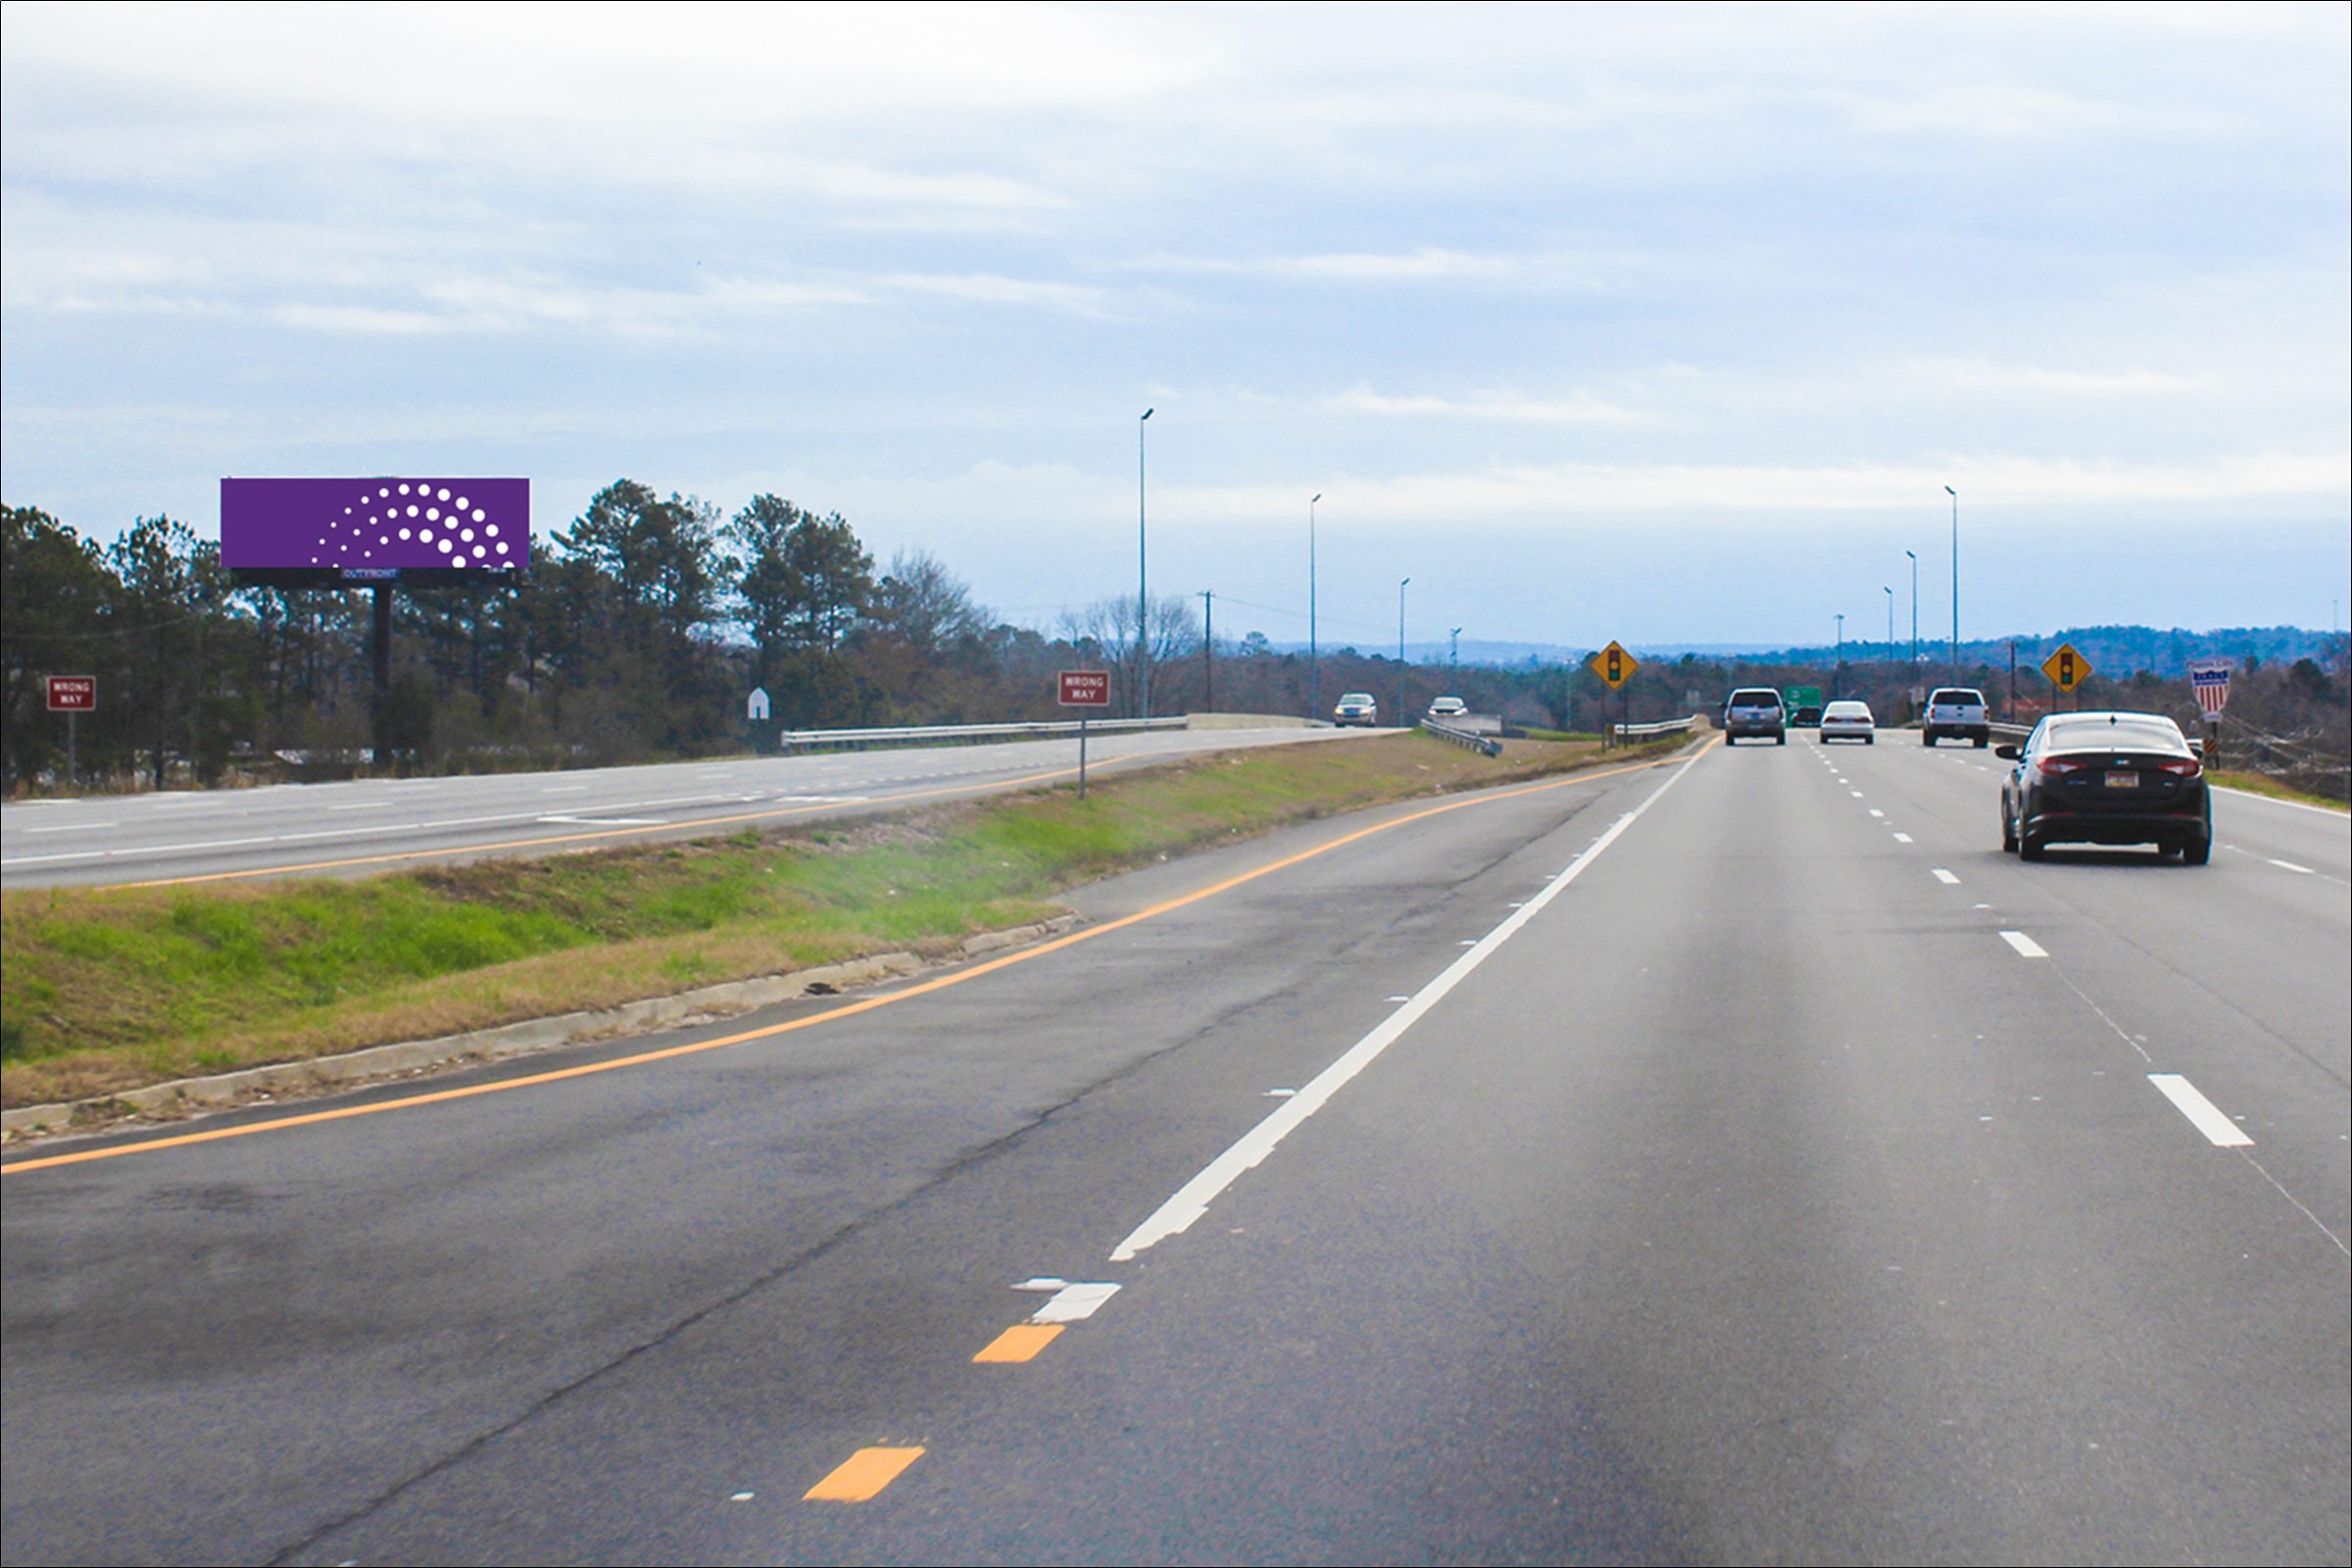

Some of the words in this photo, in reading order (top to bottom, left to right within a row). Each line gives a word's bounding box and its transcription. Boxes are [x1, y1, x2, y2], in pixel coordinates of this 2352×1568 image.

[53, 681, 90, 692] WRONG
[1064, 676, 1103, 687] WRONG
[60, 694, 82, 705] WAY
[1071, 689, 1096, 699] WAY
